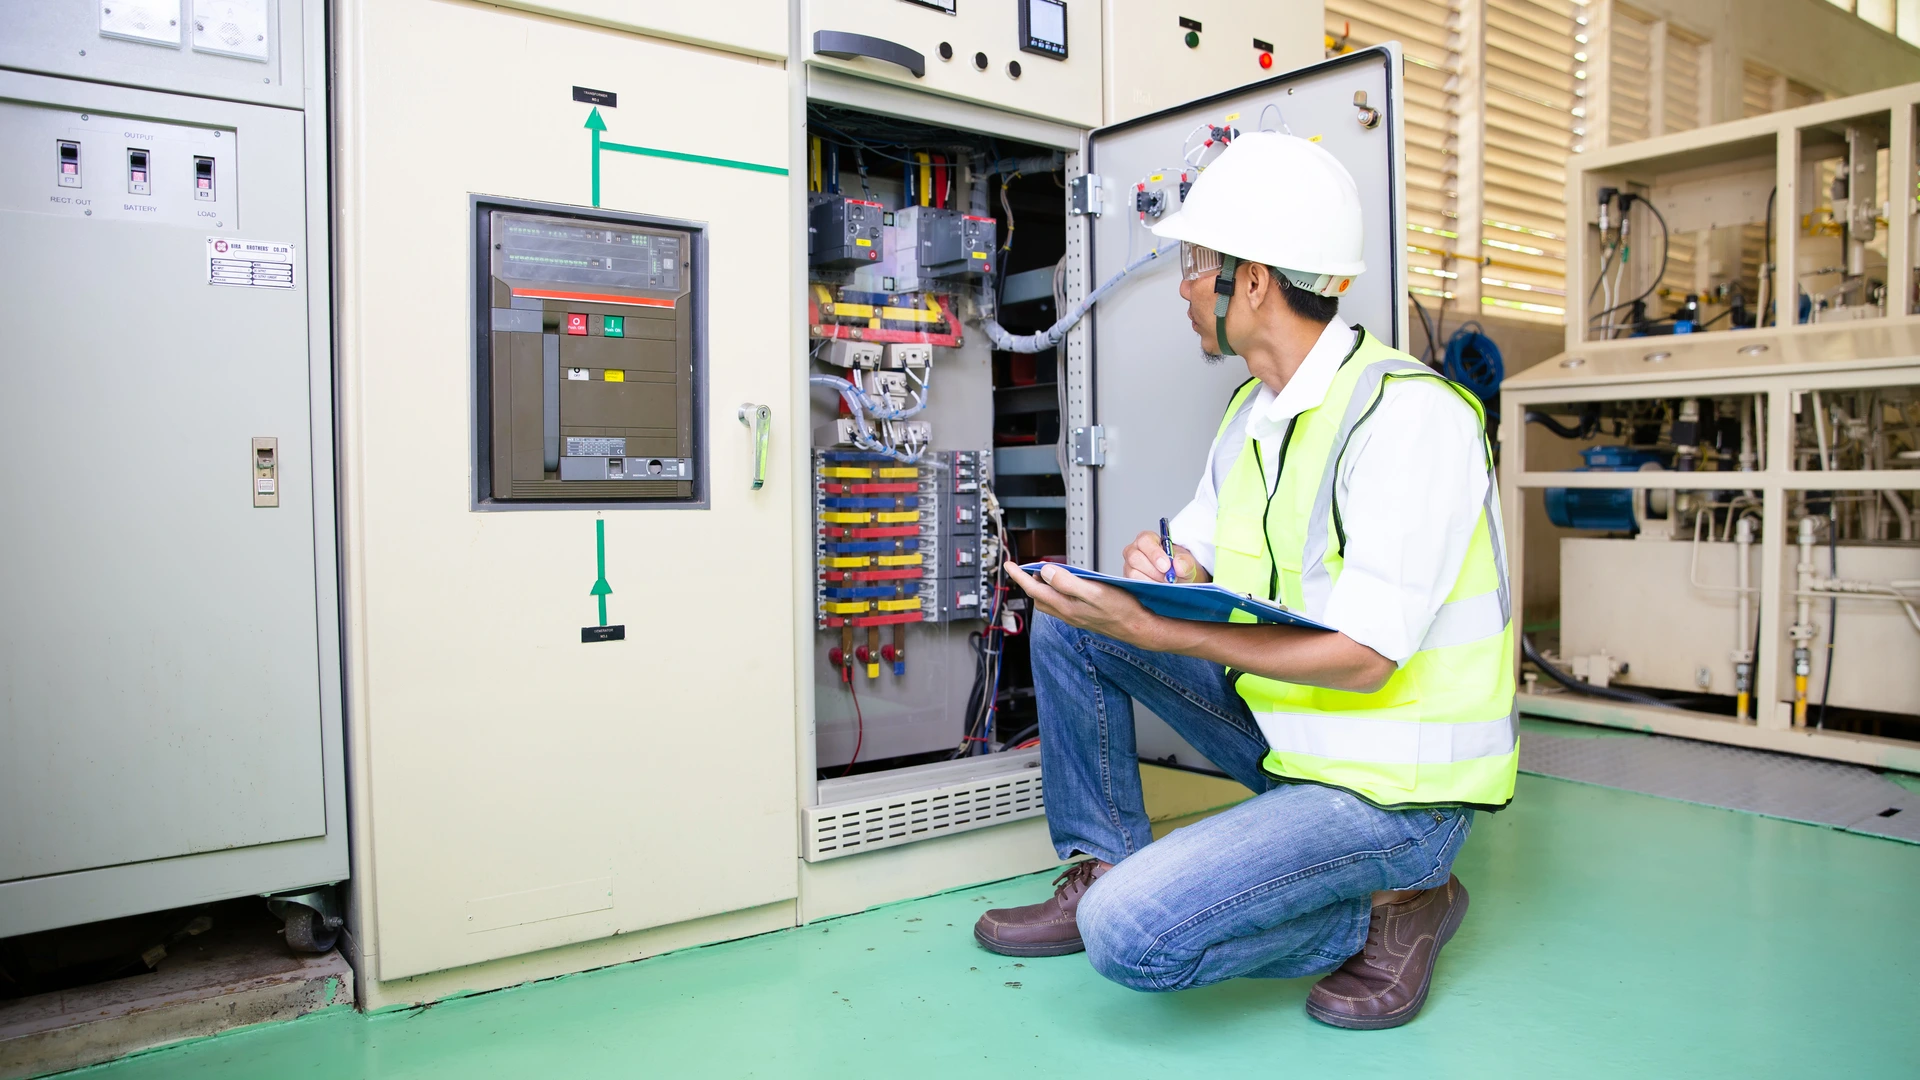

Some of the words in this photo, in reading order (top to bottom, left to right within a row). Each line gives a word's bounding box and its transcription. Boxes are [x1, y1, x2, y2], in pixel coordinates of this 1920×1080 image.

[124, 131, 154, 141] OUTPUT
[50, 196, 74, 205] RECT.
[76, 198, 92, 206] OUT
[123, 203, 158, 213] BATTERY
[197, 210, 217, 218] LOAD
